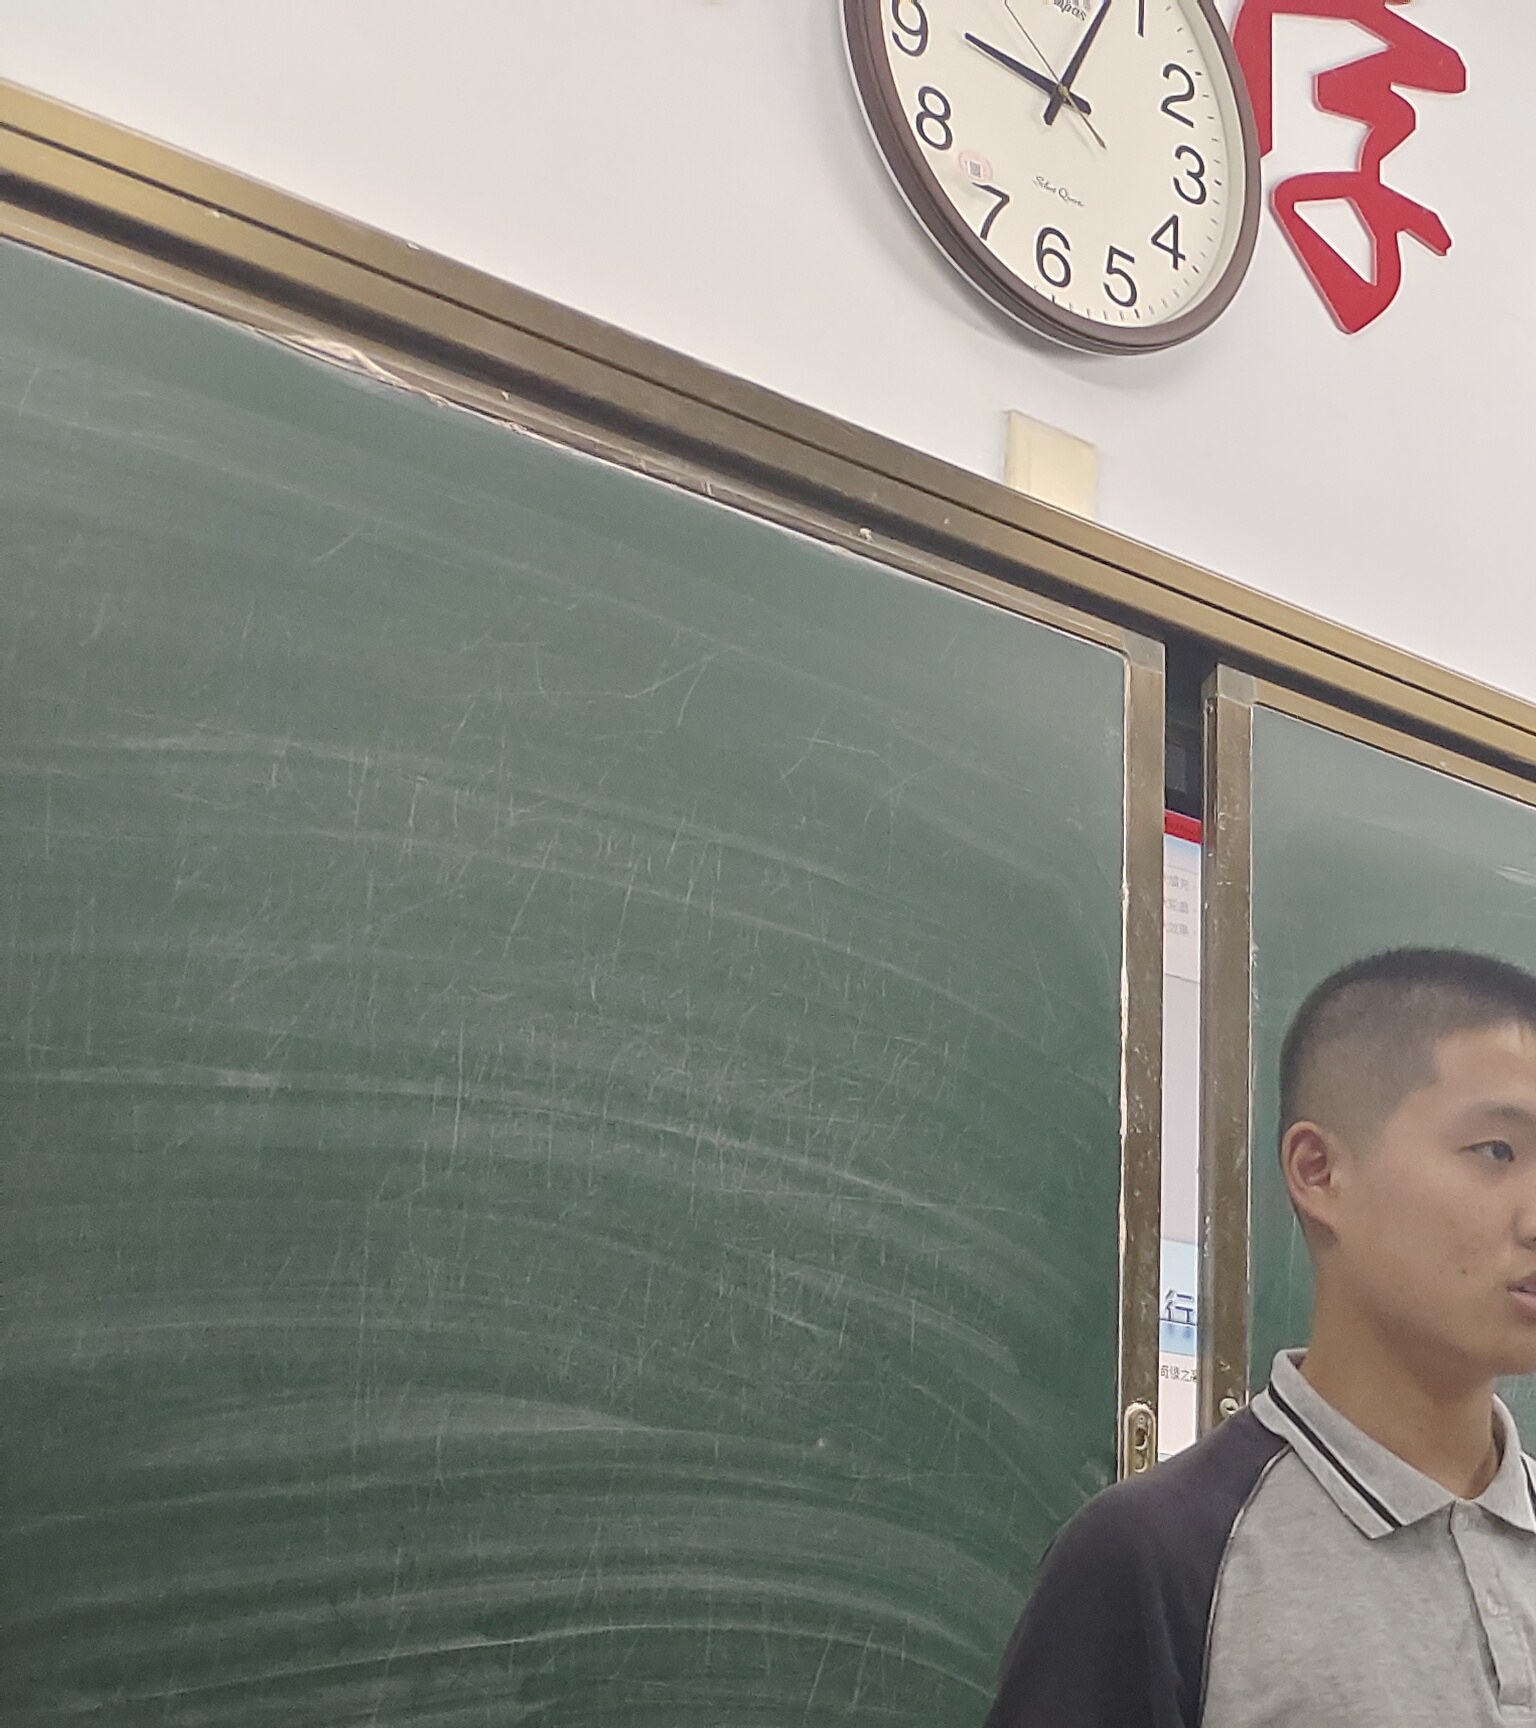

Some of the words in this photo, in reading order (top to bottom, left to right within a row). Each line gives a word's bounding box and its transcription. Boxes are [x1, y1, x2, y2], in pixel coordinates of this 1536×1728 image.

[891, 0, 928, 57] 9
[916, 86, 953, 151] 8
[1160, 63, 1195, 128] 2
[1173, 145, 1207, 205] 3
[972, 181, 1010, 241] 7
[1035, 226, 1071, 288] 6
[1151, 214, 1186, 270] 4
[1104, 246, 1137, 308] 5
[1165, 1289, 1194, 1324] 行
